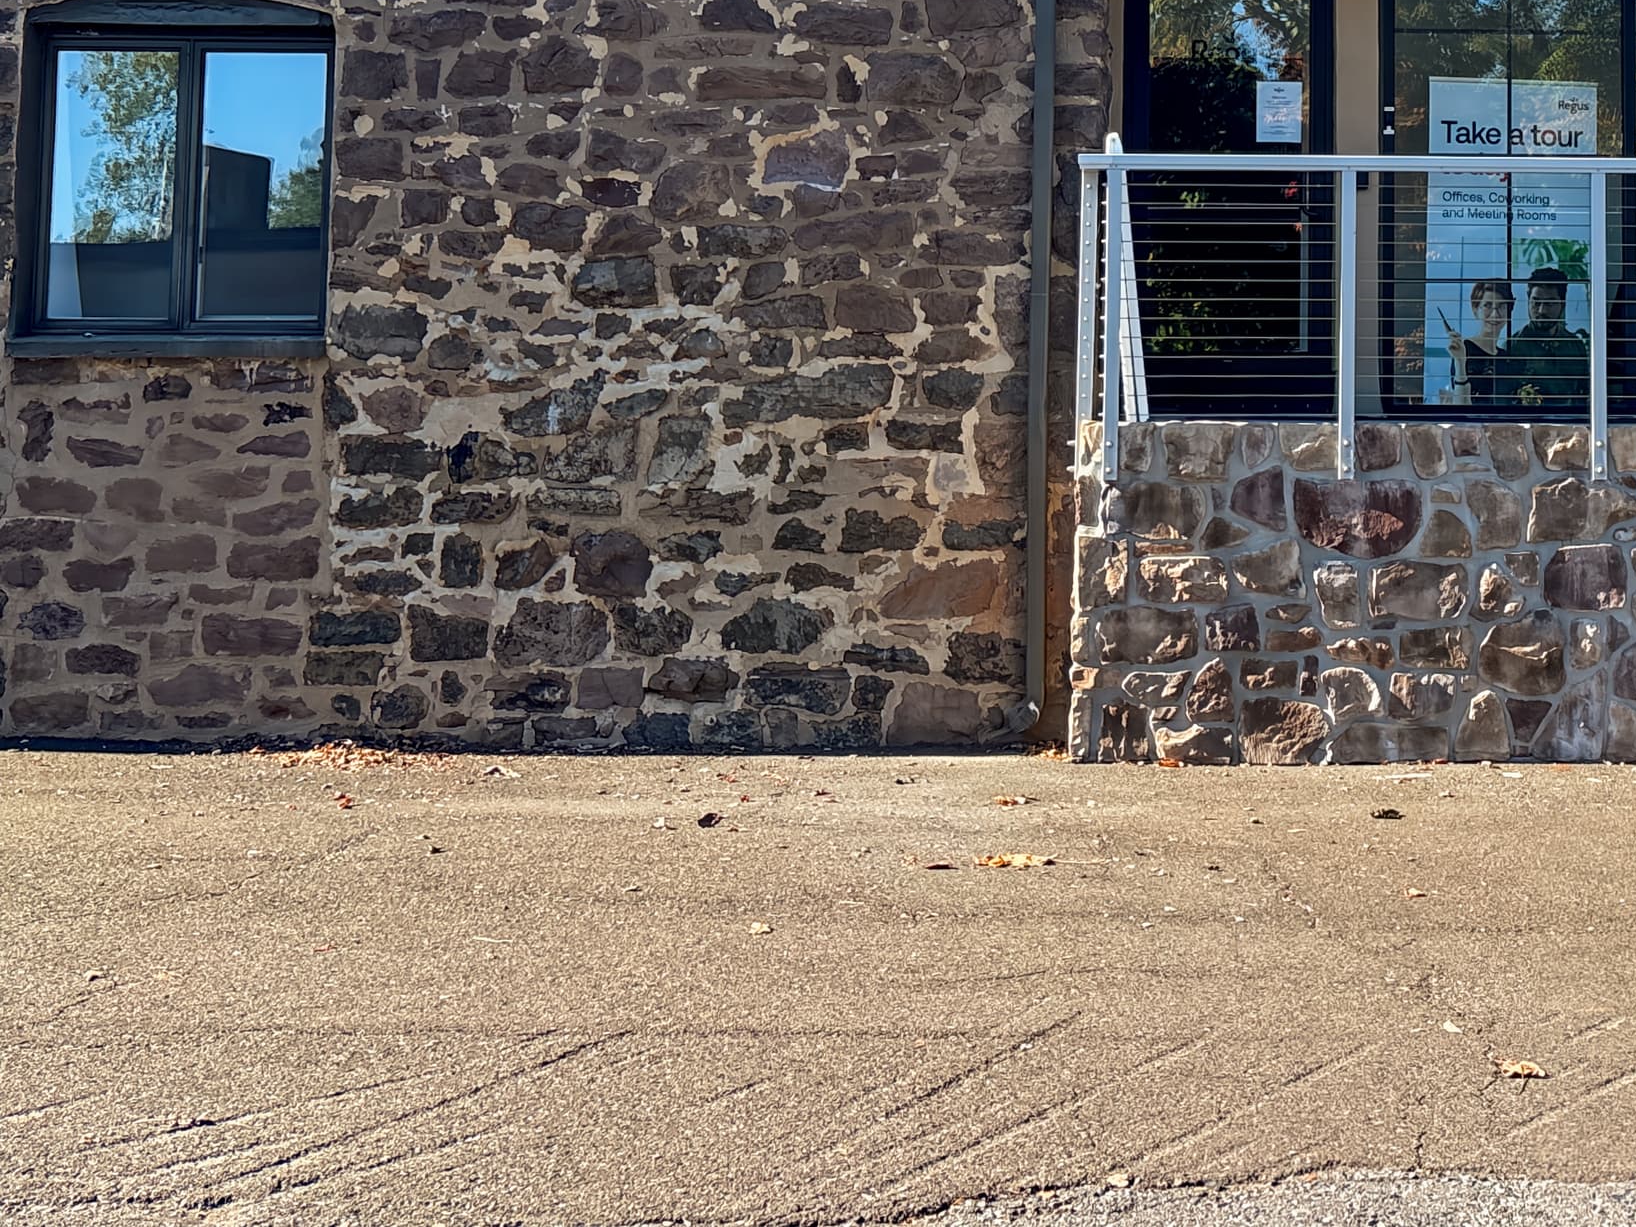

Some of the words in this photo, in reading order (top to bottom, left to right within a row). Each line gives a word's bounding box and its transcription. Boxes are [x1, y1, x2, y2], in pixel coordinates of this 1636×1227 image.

[1558, 98, 1590, 114] Regus
[1440, 120, 1502, 145] Take
[1510, 127, 1525, 146] a
[1530, 124, 1584, 148] tour
[1441, 190, 1486, 204] Offices,
[1441, 207, 1464, 219] and
[1516, 209, 1557, 221] Rooms
